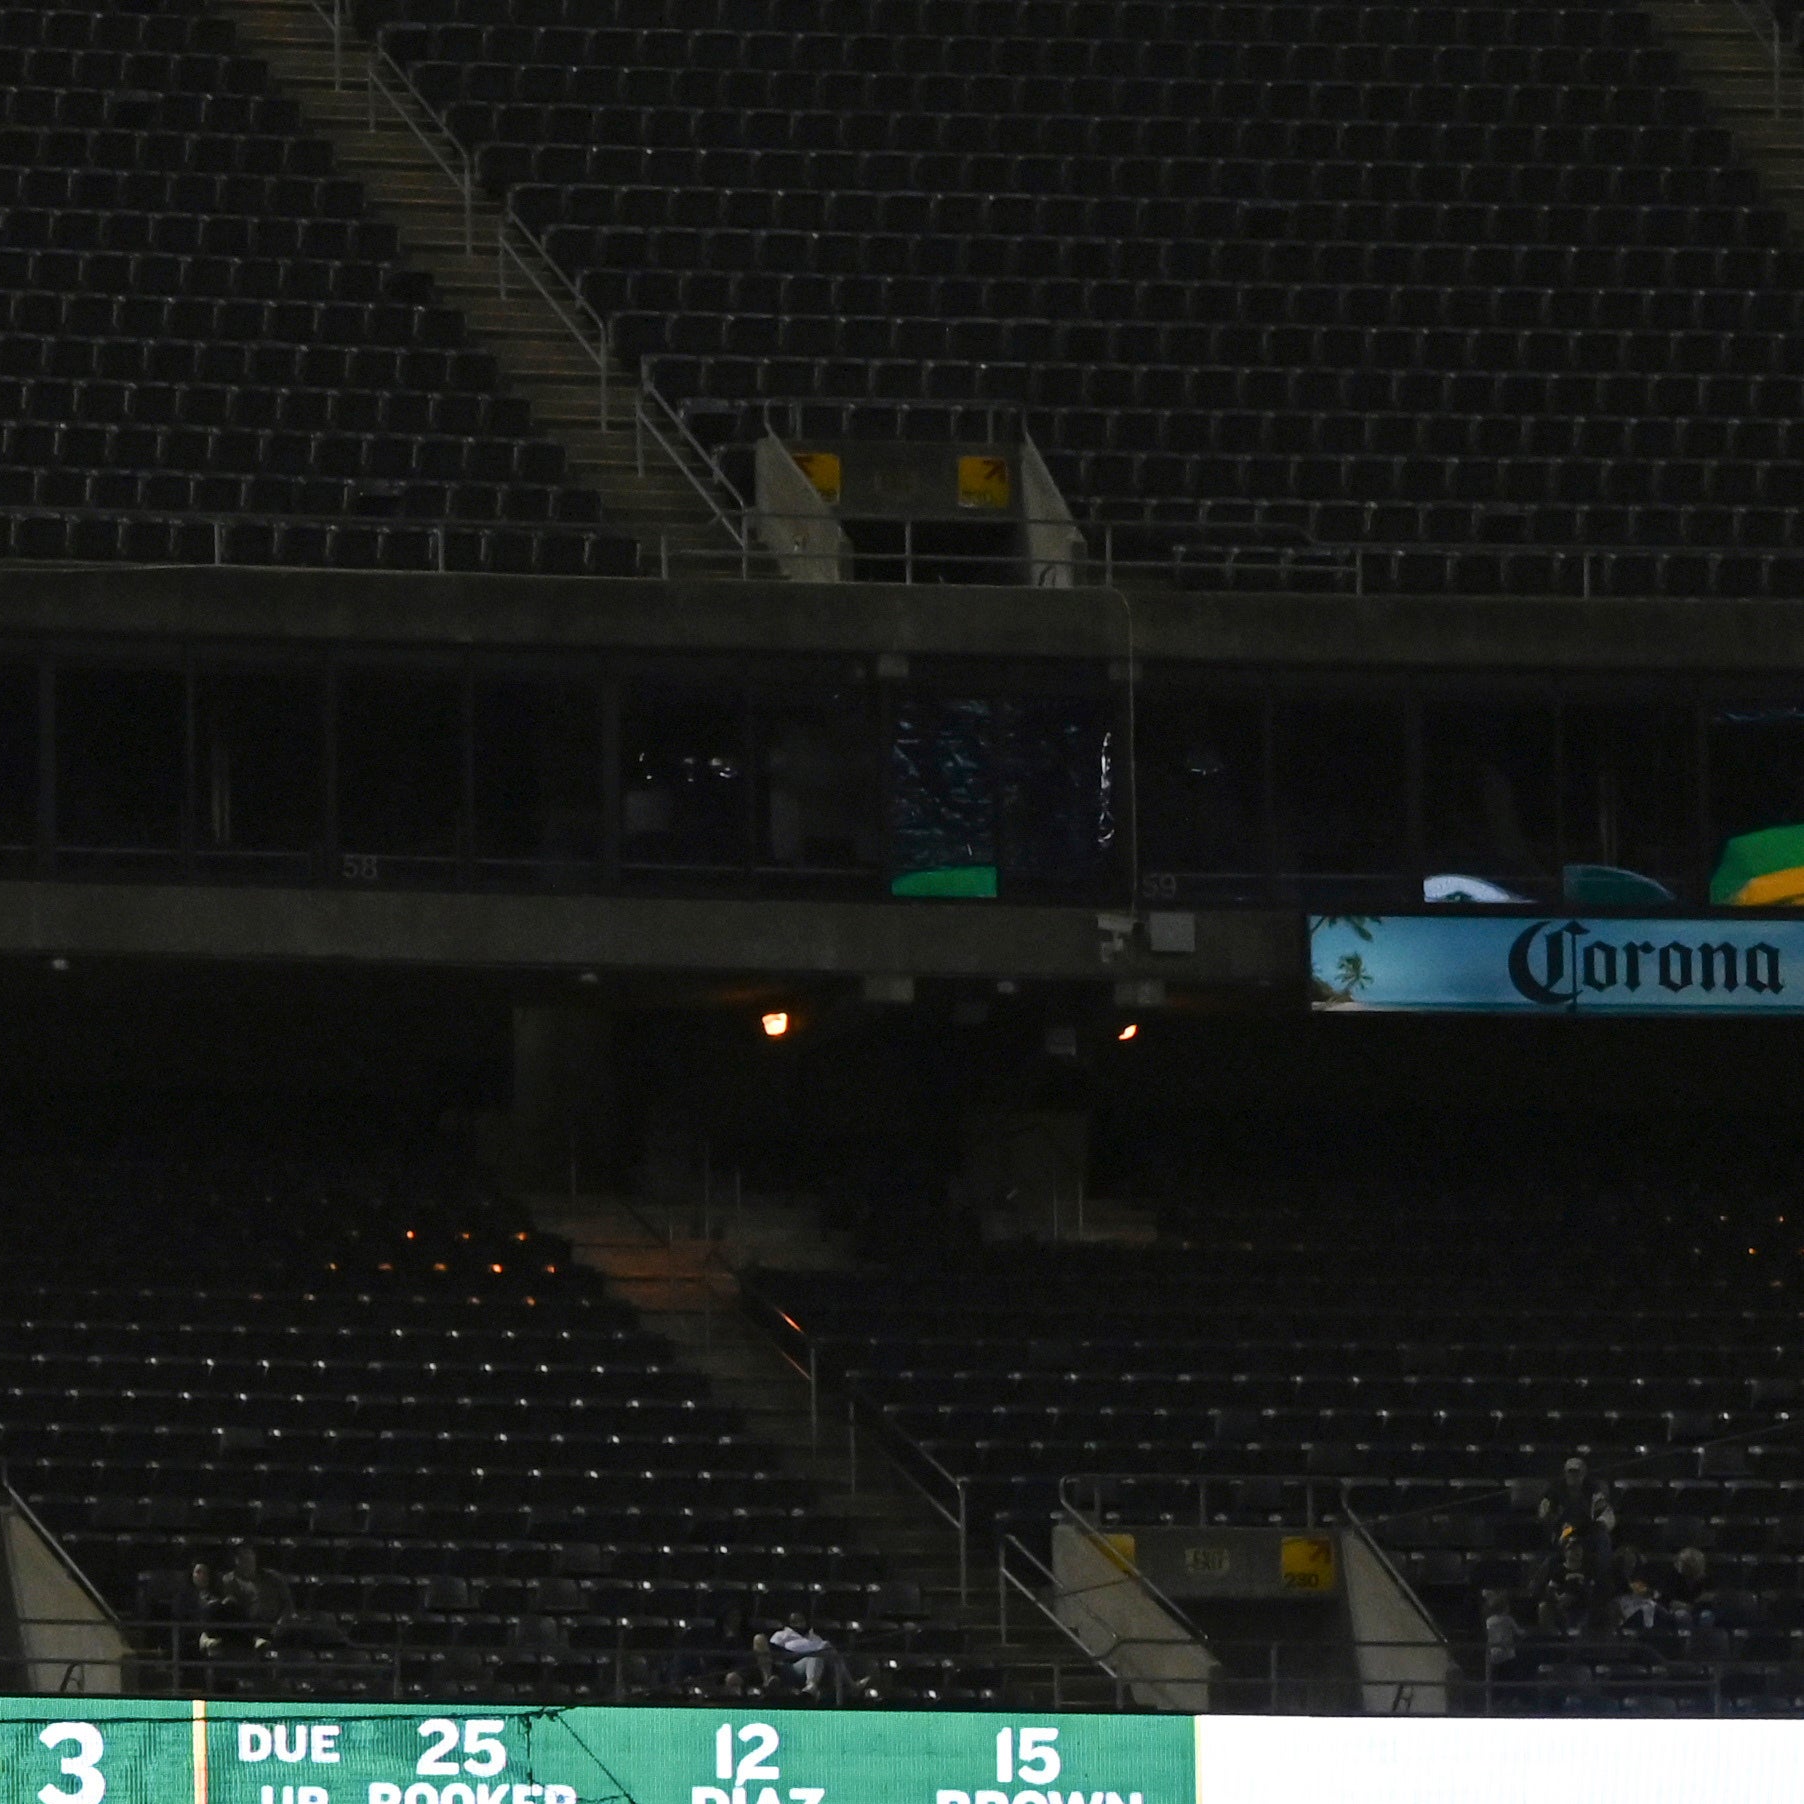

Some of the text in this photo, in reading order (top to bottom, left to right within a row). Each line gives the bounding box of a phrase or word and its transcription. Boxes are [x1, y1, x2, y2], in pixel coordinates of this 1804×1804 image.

[343, 854, 378, 880] 58
[1508, 919, 1785, 1012] Corona
[238, 1723, 340, 1765] DUE
[415, 1718, 507, 1778] 25
[715, 1722, 781, 1781] 12
[995, 1726, 1060, 1786] 15
